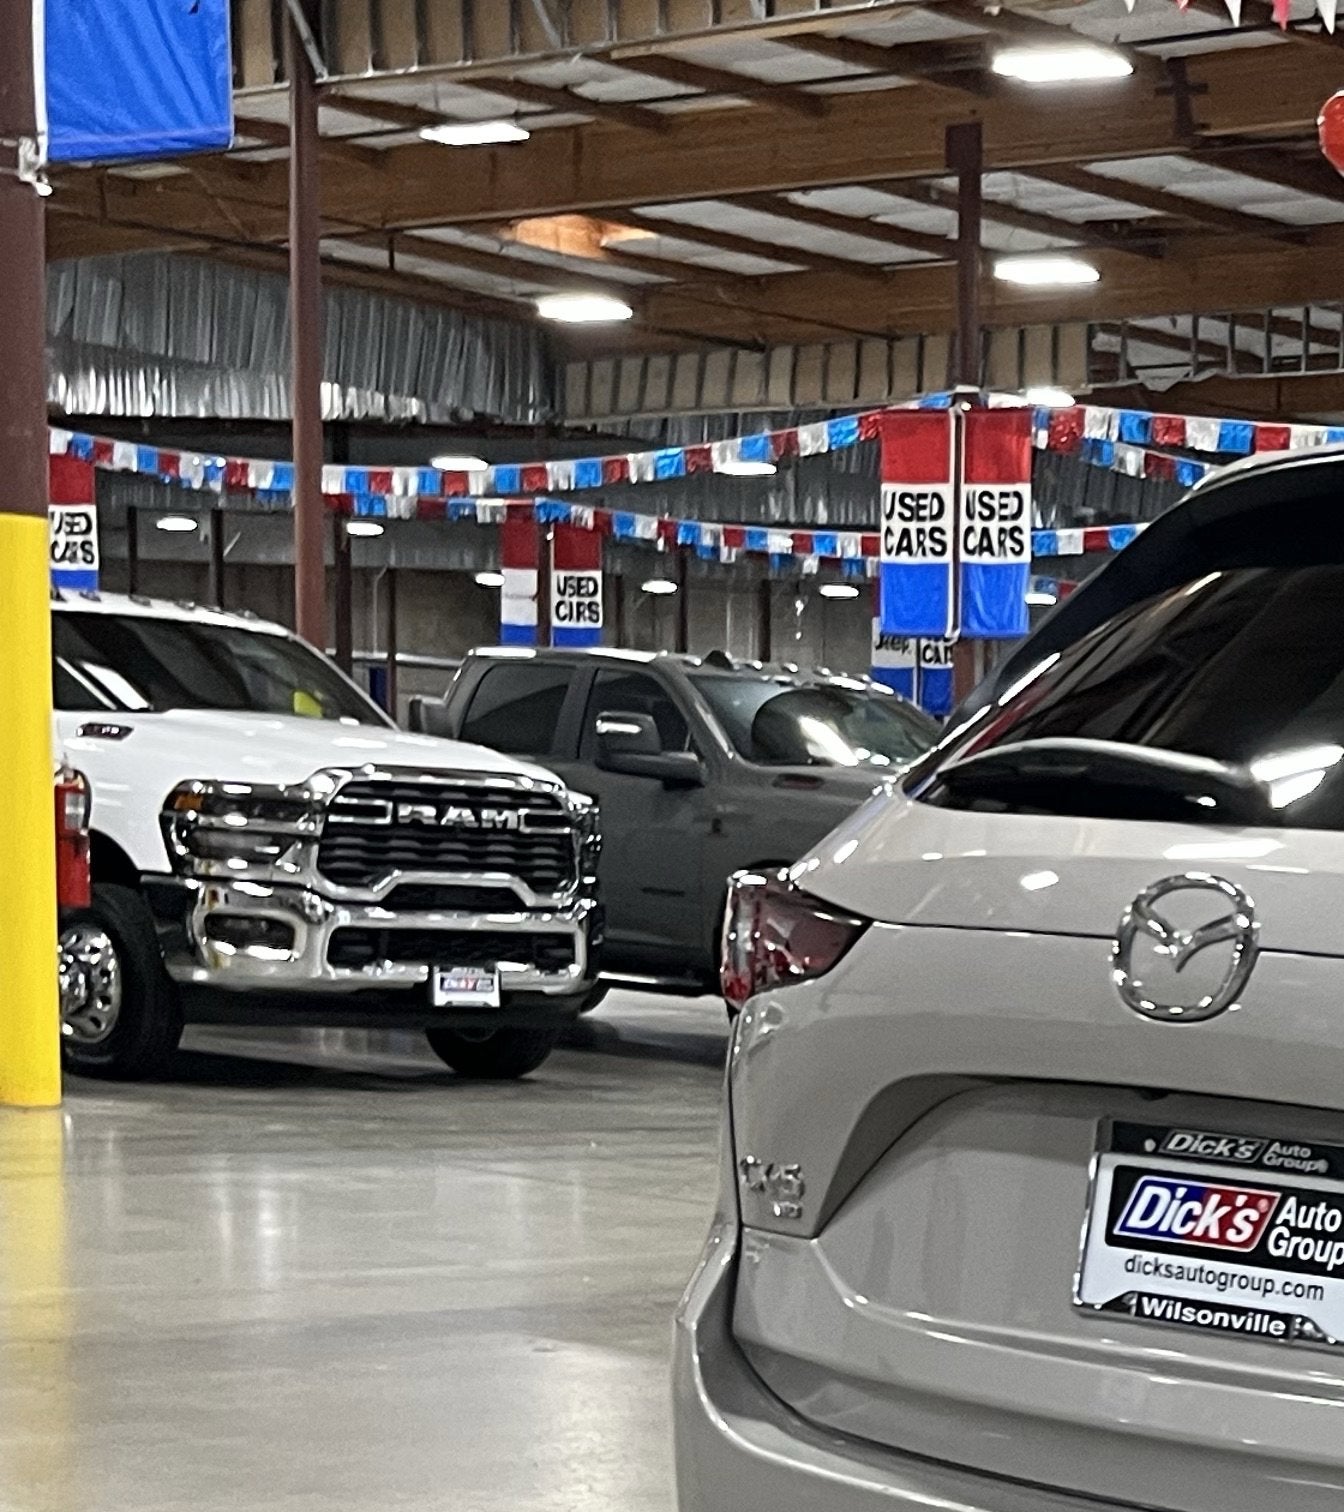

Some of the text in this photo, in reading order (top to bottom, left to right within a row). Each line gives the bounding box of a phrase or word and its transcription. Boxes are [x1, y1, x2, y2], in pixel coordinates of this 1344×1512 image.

[883, 490, 945, 522] USED
[965, 490, 1024, 522] USED
[884, 526, 948, 557] CARS
[963, 526, 1025, 558] CARS
[398, 803, 518, 830] RAM
[1166, 1133, 1312, 1160] Dick's Auto
[1126, 1185, 1343, 1253] Dick's Auto
[1125, 1255, 1324, 1301] dicksautogroup.com
[1141, 1296, 1286, 1336] Wilsonville
